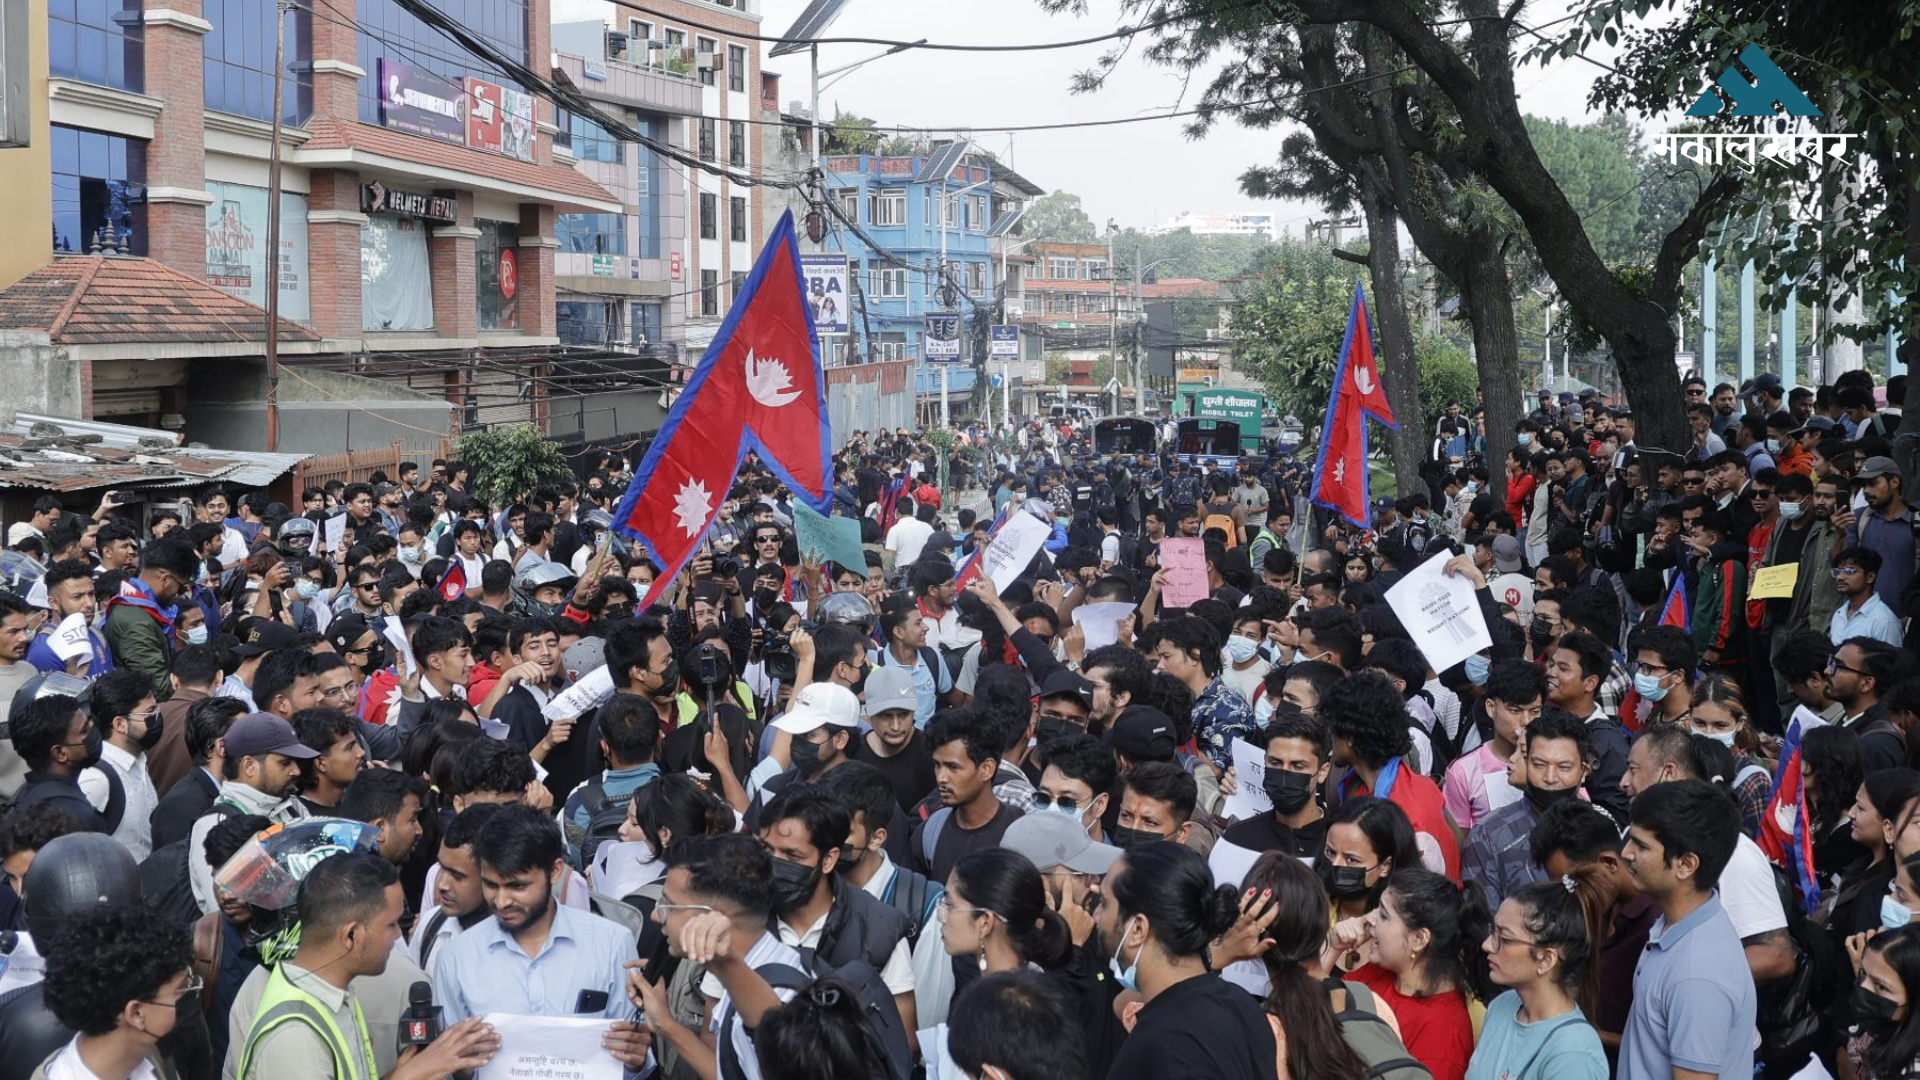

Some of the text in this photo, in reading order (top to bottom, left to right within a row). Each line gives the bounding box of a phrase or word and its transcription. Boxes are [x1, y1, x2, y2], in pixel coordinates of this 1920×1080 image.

[390, 191, 453, 218] HELMETS NEPAL
[1224, 396, 1257, 408] शौचालय
[1430, 600, 1452, 616] NATION
[1426, 620, 1447, 634] BRIGHT
